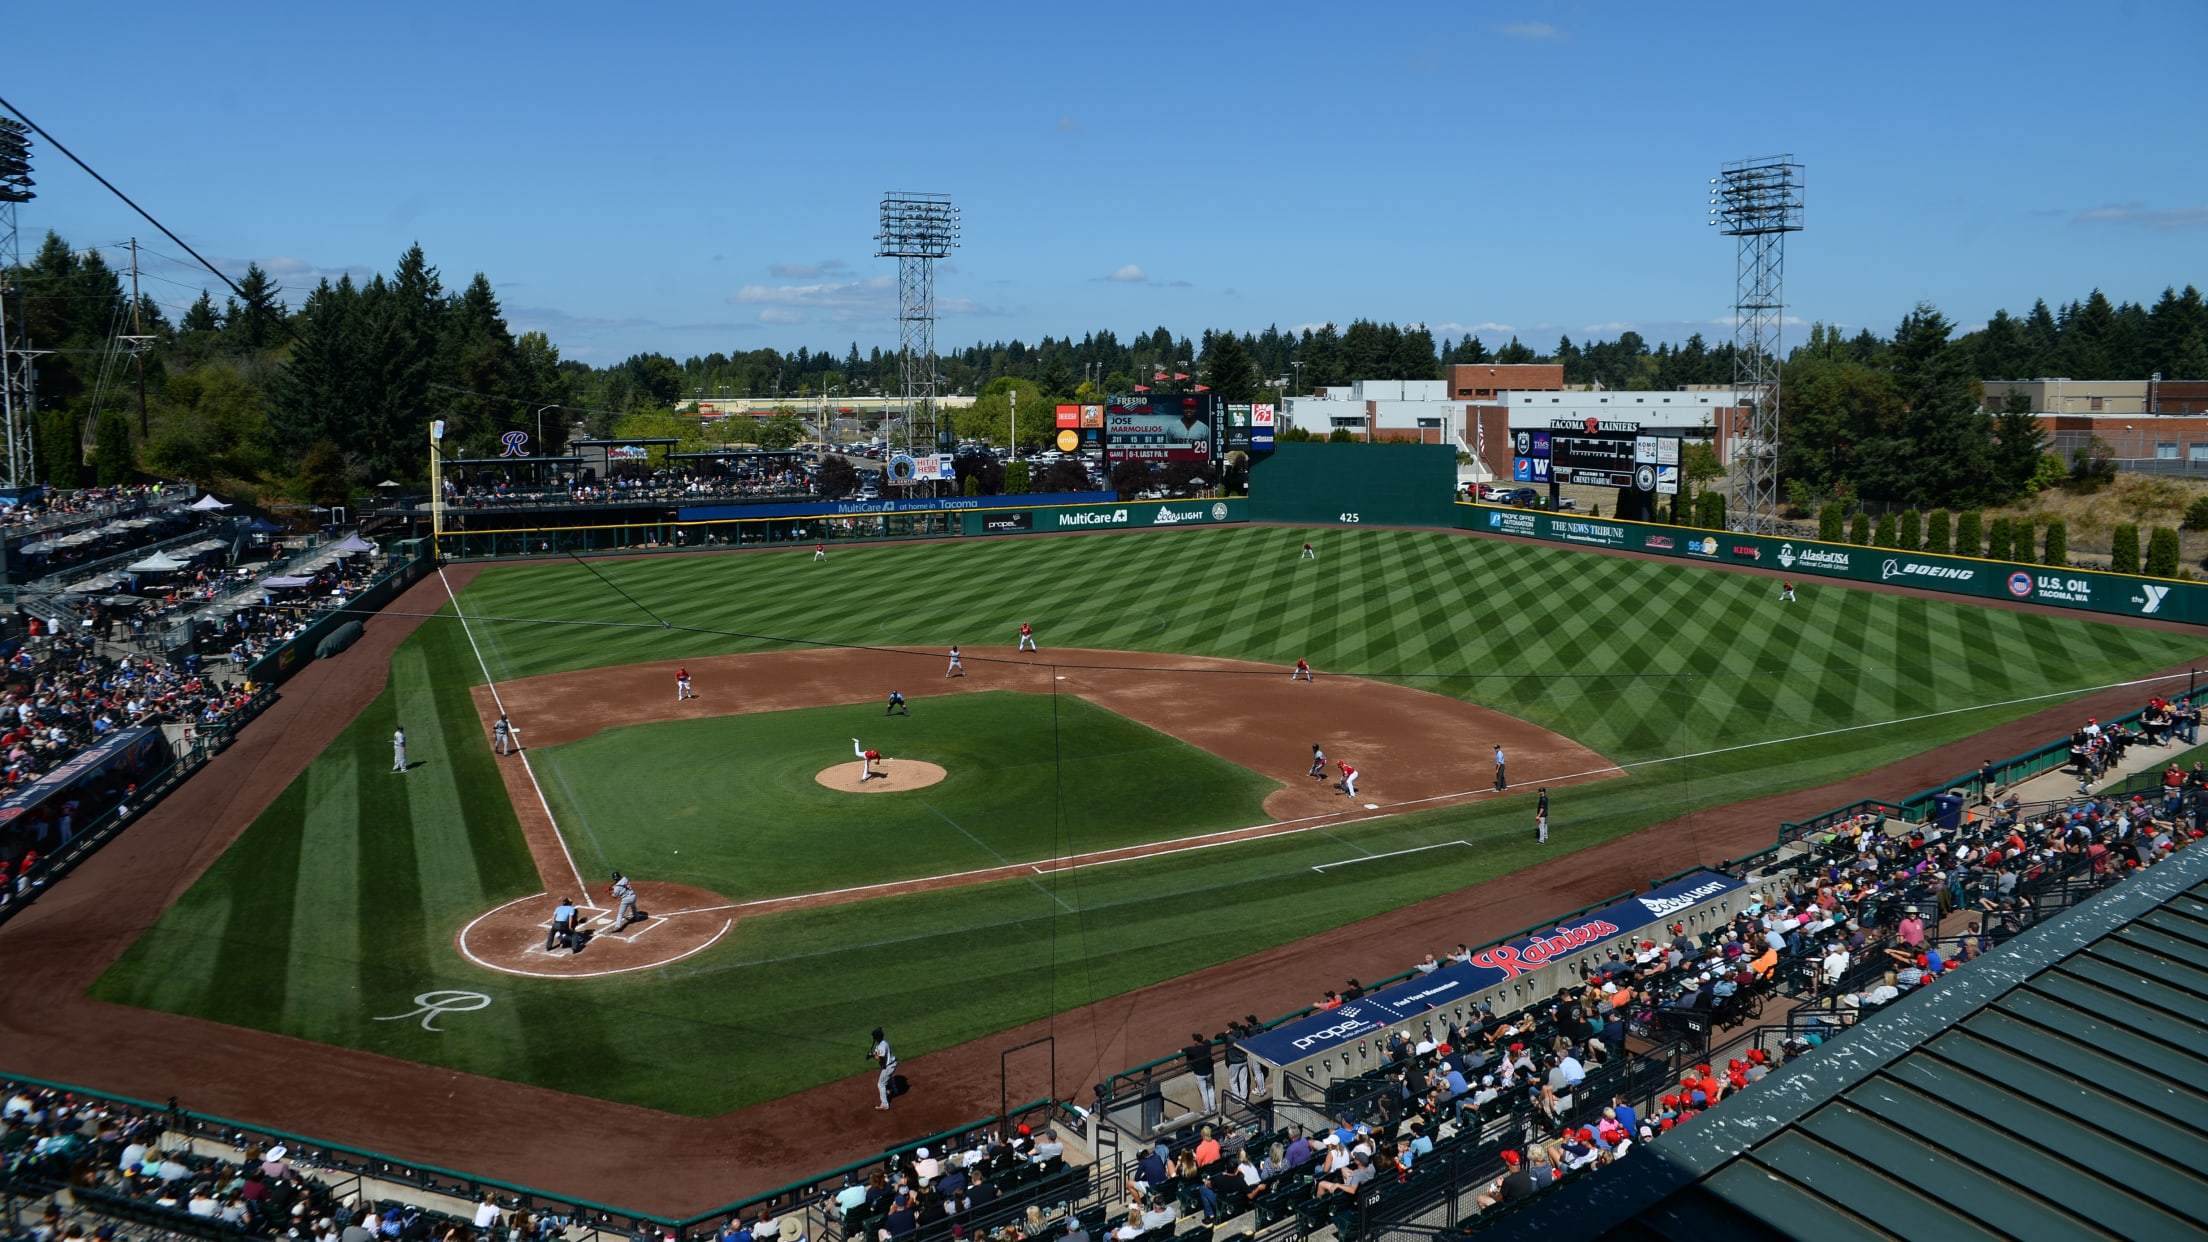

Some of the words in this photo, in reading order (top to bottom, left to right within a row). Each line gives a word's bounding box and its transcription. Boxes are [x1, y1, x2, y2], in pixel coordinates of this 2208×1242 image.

[1117, 397, 1148, 405] FRESNO
[1551, 420, 1585, 430] TACOMA
[1584, 417, 1598, 434] R
[1599, 421, 1637, 432] RAINIERS
[500, 431, 530, 457] R
[1194, 441, 1207, 453] 29
[1533, 458, 1550, 475] W
[839, 499, 880, 513] MultiCare
[900, 502, 906, 510] at
[909, 501, 928, 510] home
[939, 499, 978, 509] Tacoma
[1059, 511, 1111, 526] MultiCare
[1181, 511, 1203, 520] LIGHT
[1340, 513, 1359, 522] 425
[1501, 512, 1518, 520] PACIFIC
[1519, 513, 1535, 522] OFFICE
[1503, 519, 1534, 528] AUTOMATION
[1551, 520, 1567, 531] THE
[1568, 521, 1589, 534] NEWS
[1590, 524, 1624, 538] TRIBUNE
[1799, 549, 1849, 564] AlaskaUSA
[1903, 563, 1974, 580] BOEING
[2038, 576, 2063, 590] U.S.
[2067, 580, 2091, 593] OIL
[2039, 590, 2075, 601] TACOMA,
[2075, 593, 2088, 602] WA
[2131, 595, 2144, 604] the
[1684, 881, 1727, 899] LIGHT
[1469, 919, 1619, 981] Rainiers
[1802, 968, 1814, 977] 122
[1407, 993, 1425, 1001] Your
[1422, 980, 1459, 996] Momentum
[1688, 1022, 1700, 1031] 122
[1368, 1194, 1380, 1205] 120
